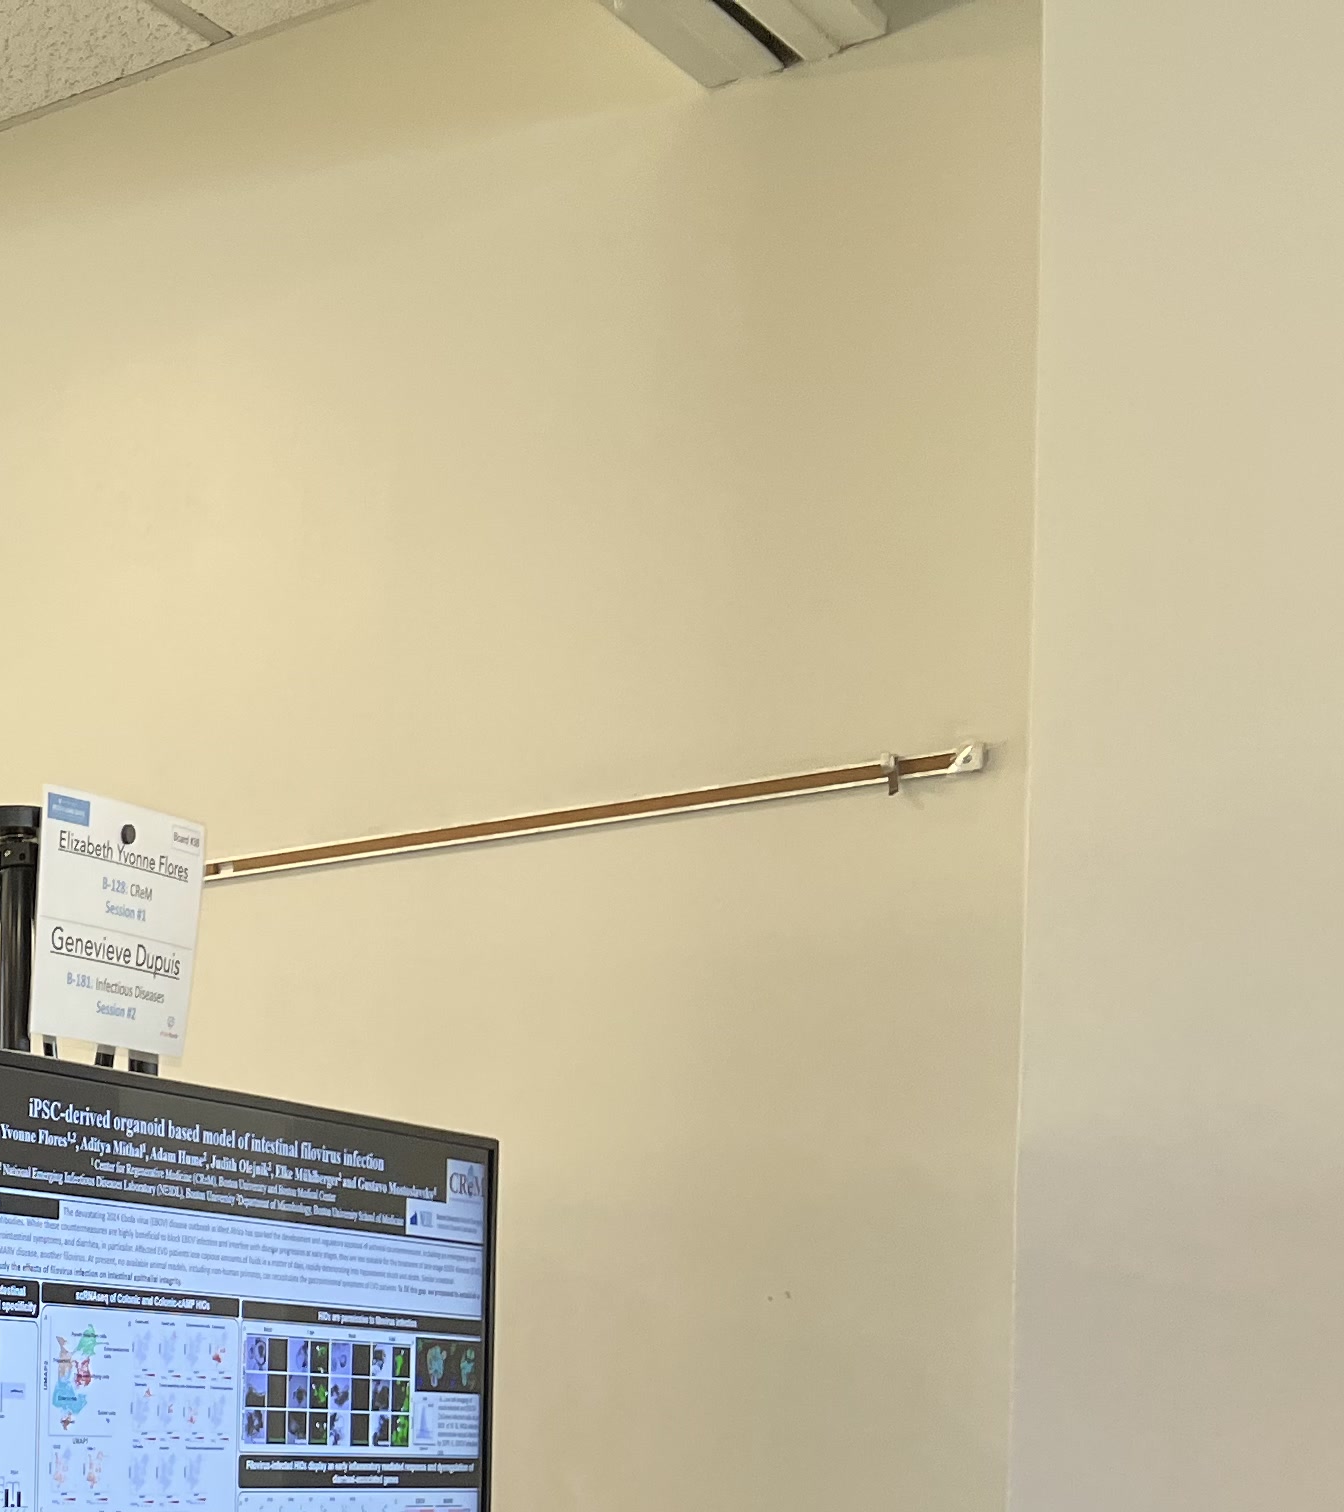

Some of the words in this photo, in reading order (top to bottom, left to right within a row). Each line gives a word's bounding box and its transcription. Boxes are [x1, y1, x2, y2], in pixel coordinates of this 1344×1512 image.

[58, 830, 113, 859] Elizabeth
[116, 844, 156, 870] Yvonne
[158, 855, 188, 878] Flores
[129, 883, 152, 900] CReM
[104, 900, 135, 918] Session
[136, 908, 146, 921] #1
[51, 926, 131, 963] Genevieve
[135, 943, 180, 979] Dupuis
[95, 978, 133, 996] Infectious
[134, 985, 164, 1003] Diseases
[95, 1000, 125, 1017] Session
[28, 1097, 110, 1128] iPSC-derived
[113, 1117, 165, 1137] organoid
[168, 1120, 200, 1142] based
[202, 1128, 235, 1147] model
[237, 1132, 250, 1150] of
[250, 1134, 298, 1157] intestinal
[300, 1142, 341, 1163] filovirus
[342, 1149, 384, 1170] infection
[0, 1123, 36, 1142] Yvonne
[79, 1136, 112, 1156] Aditya
[149, 1146, 176, 1162] Adam
[210, 1154, 237, 1171] Judith
[342, 1176, 356, 1188] and
